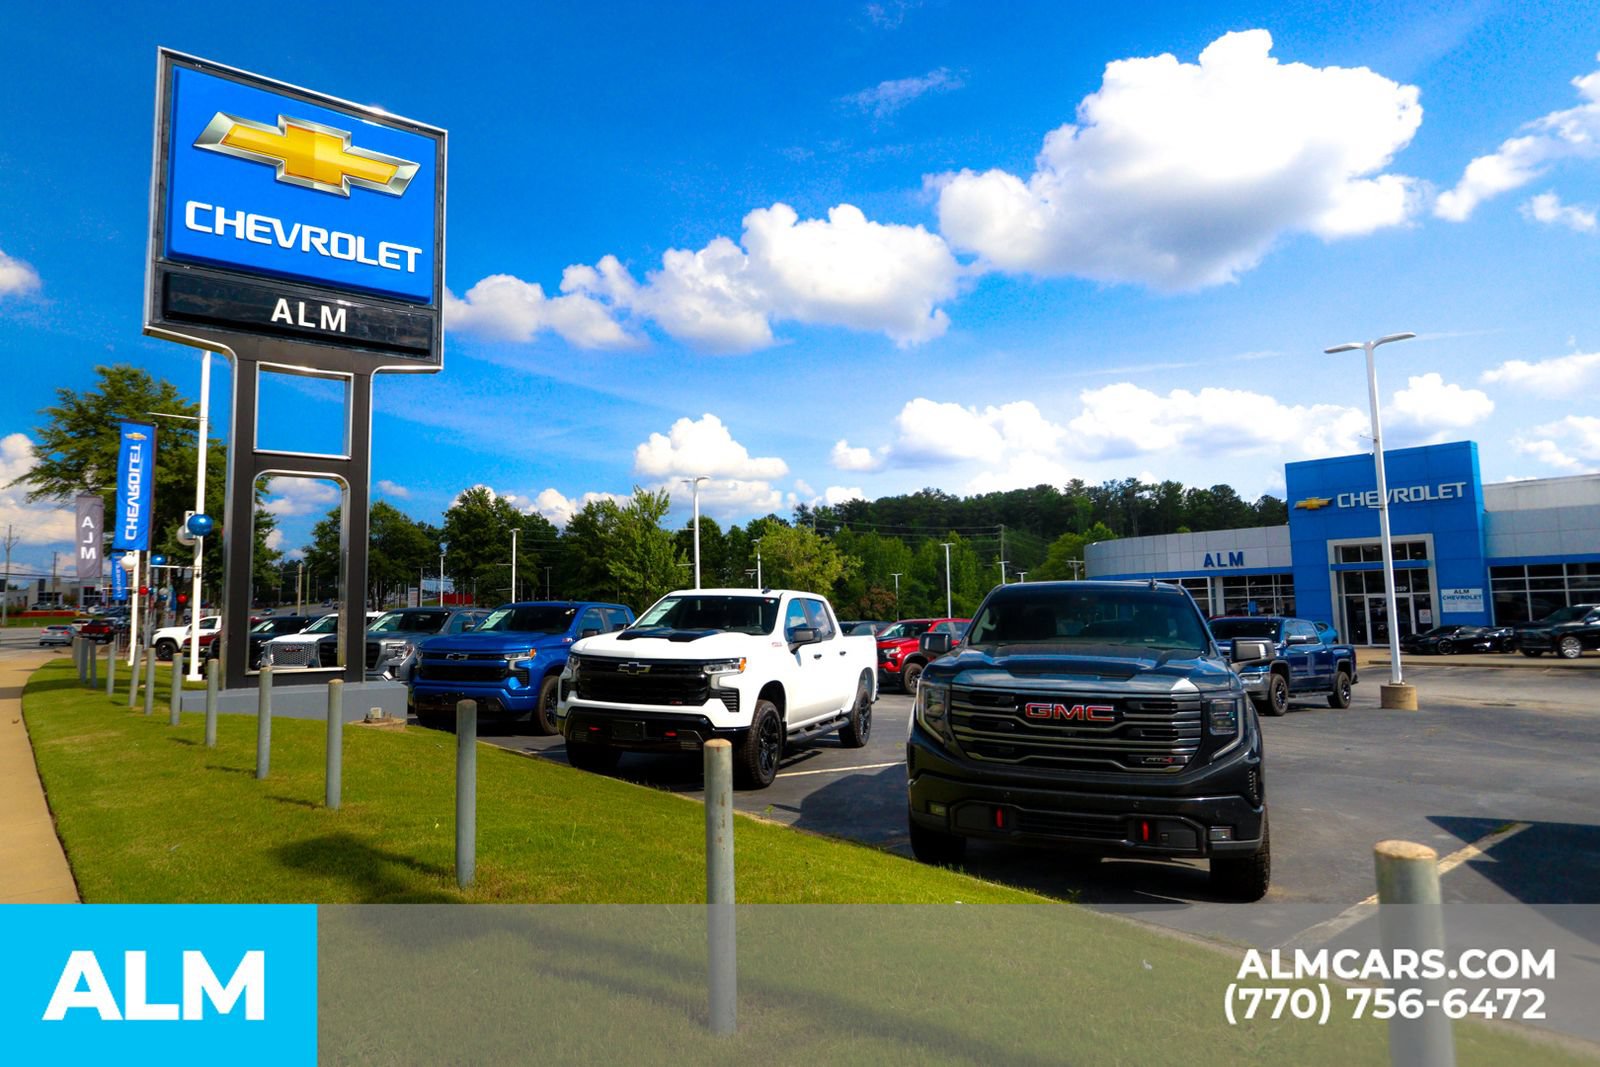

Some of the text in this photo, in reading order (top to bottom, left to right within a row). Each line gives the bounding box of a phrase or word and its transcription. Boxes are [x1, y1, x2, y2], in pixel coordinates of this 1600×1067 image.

[185, 200, 422, 273] CHEVROLET
[270, 298, 347, 332] ALM
[1203, 551, 1245, 568] ALM
[1025, 703, 1114, 721] GMC
